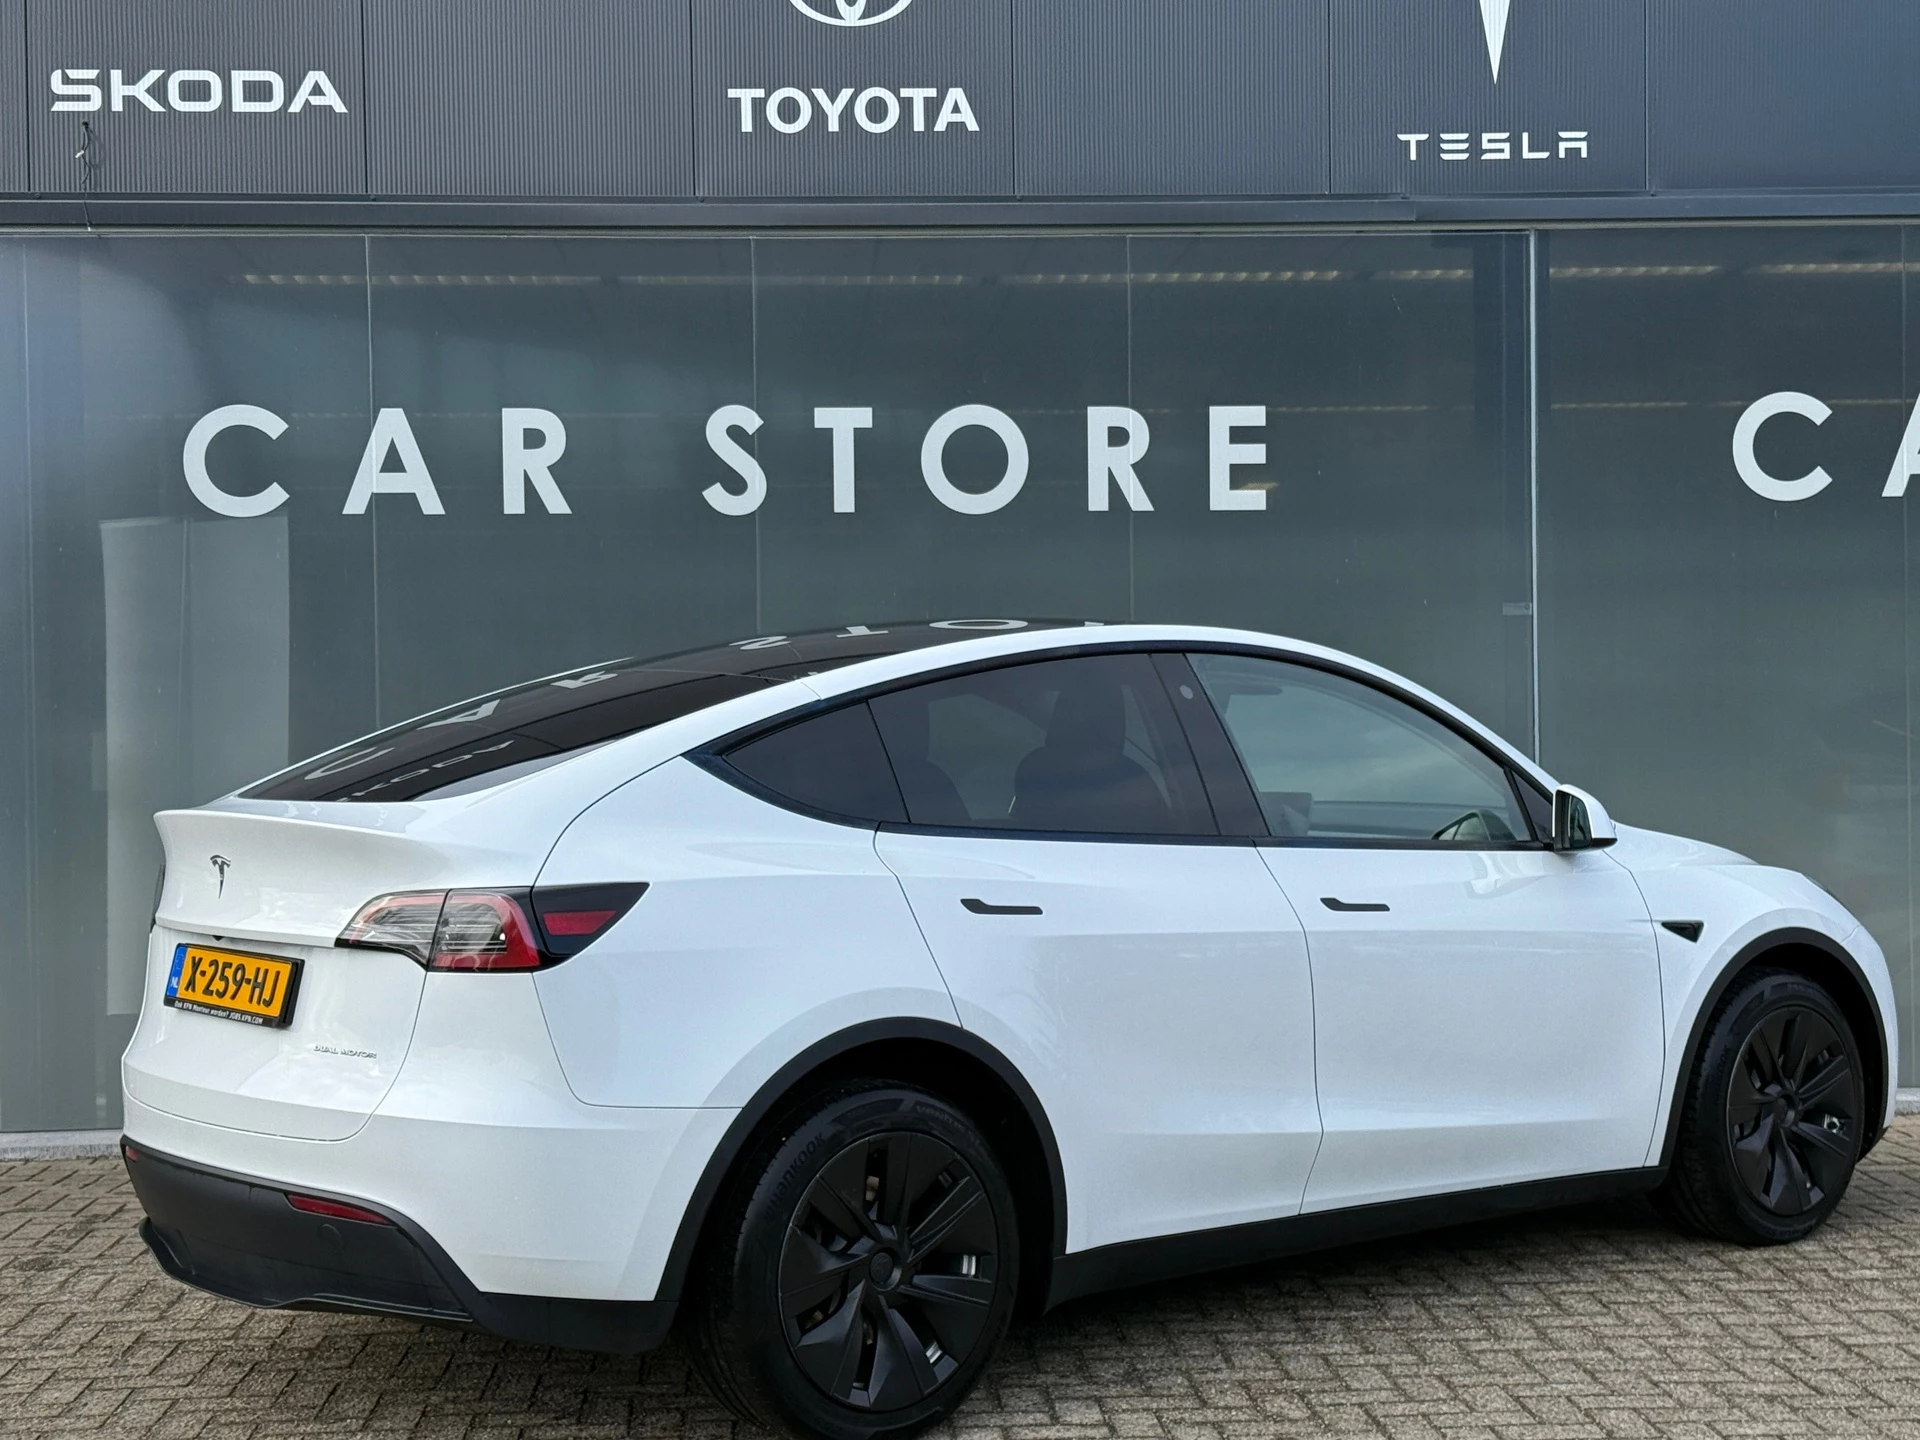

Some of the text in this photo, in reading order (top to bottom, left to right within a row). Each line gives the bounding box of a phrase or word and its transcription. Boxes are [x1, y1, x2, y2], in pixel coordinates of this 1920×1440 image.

[51, 69, 348, 113] SKODA
[727, 86, 980, 134] TOYOTA
[1396, 131, 1588, 161] TESLA
[183, 404, 1267, 517] CAR STORE
[170, 976, 179, 989] NL
[184, 956, 281, 1008] X-259-HJ
[313, 1045, 377, 1059] DUAL MOTOR
